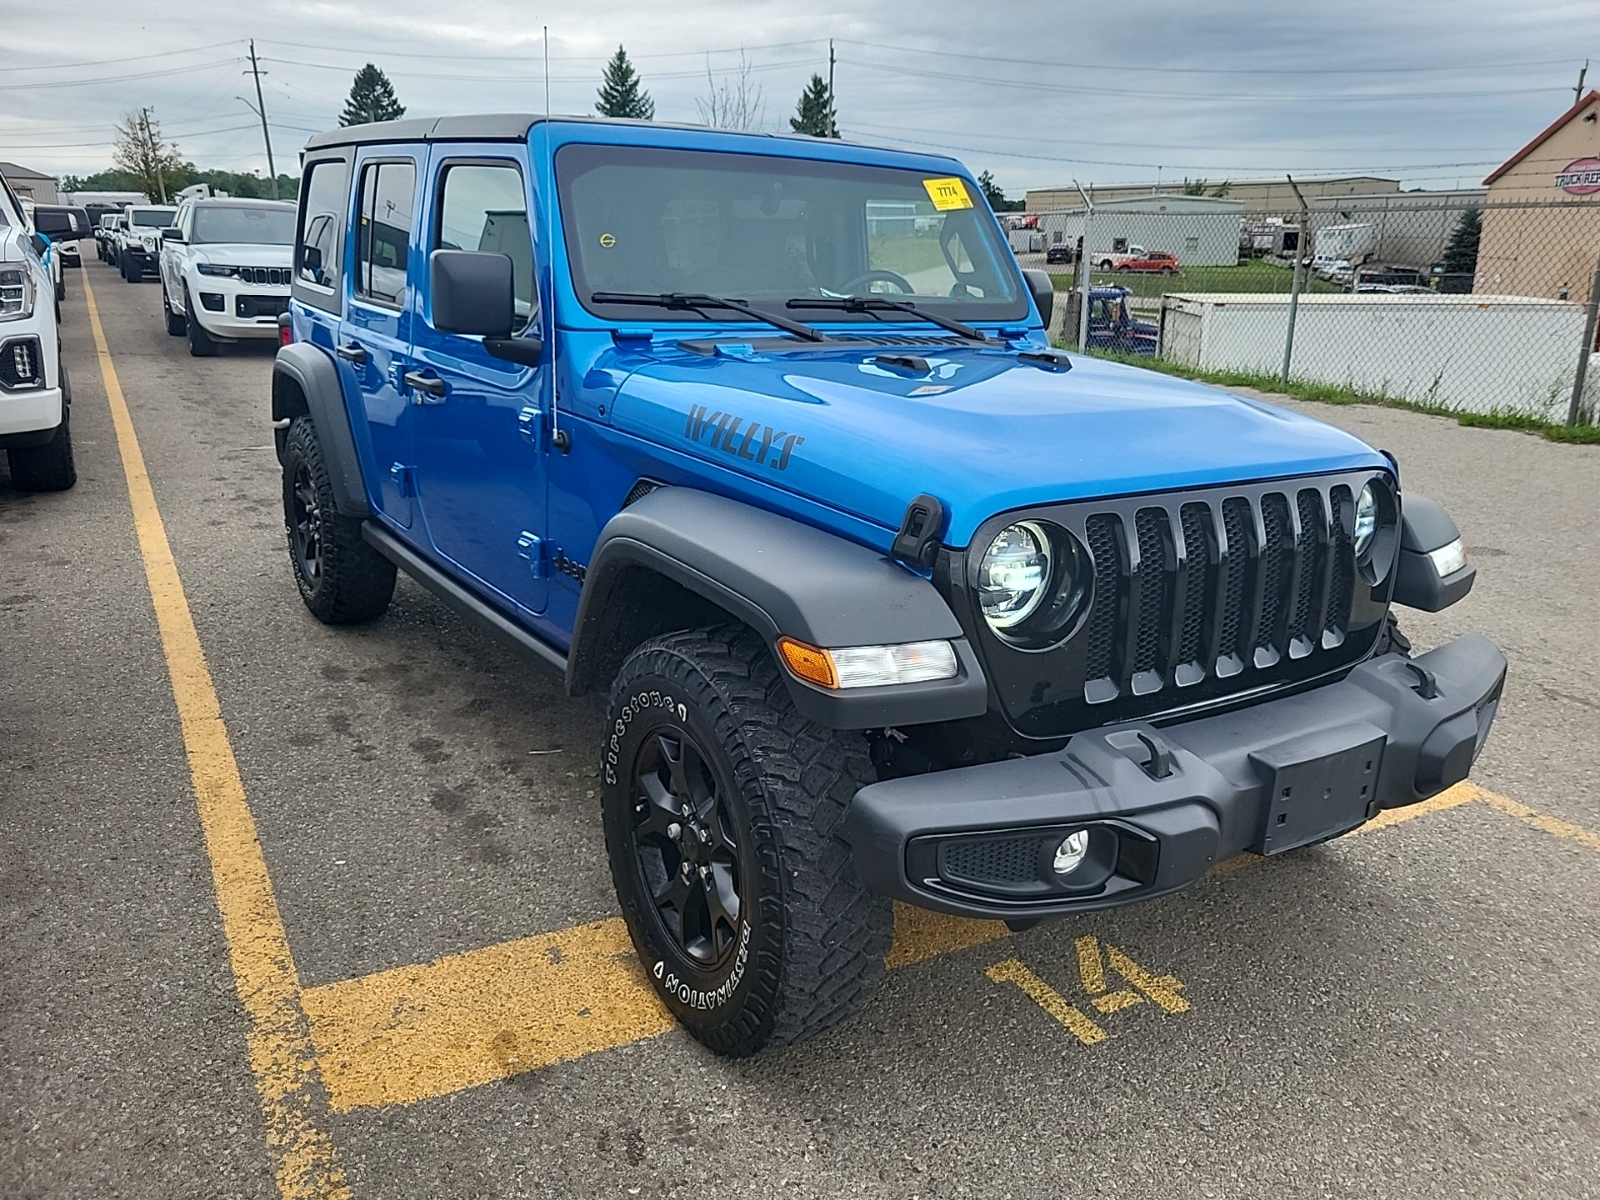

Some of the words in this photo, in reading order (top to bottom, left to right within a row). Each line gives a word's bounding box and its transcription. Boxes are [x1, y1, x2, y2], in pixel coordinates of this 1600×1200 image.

[936, 186, 958, 198] 7774
[1554, 173, 1583, 188] TRUCK
[684, 403, 806, 471] WILLYS
[605, 690, 676, 785] Firestone
[665, 919, 752, 1010] DESTINATION
[982, 933, 1191, 1046] 14
